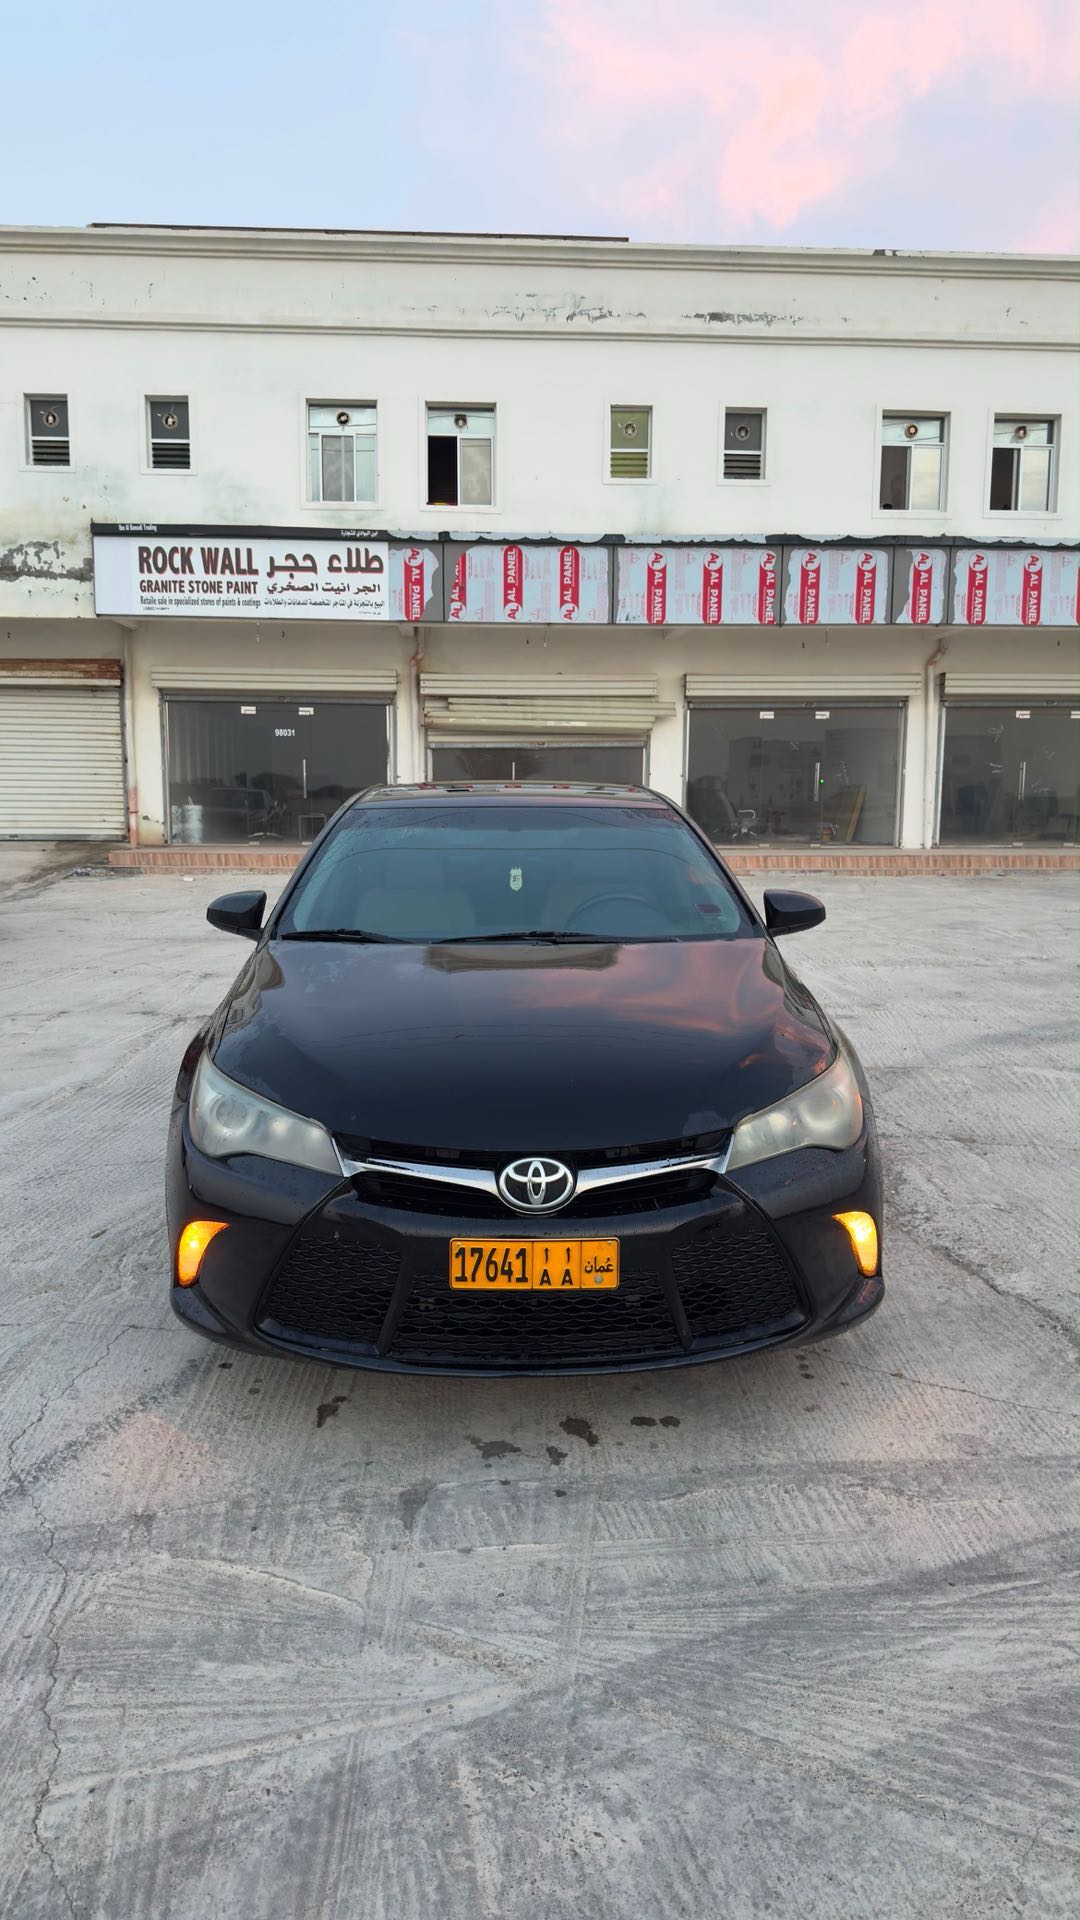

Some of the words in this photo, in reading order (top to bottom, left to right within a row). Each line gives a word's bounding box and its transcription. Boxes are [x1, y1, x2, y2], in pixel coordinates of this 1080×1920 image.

[144, 524, 157, 532] Trading
[138, 546, 195, 574] ROCK
[200, 546, 259, 576] WALL
[266, 553, 318, 579] حجر
[327, 547, 384, 574] طلاء
[507, 548, 515, 584] PANEL
[564, 549, 572, 584] PANEL
[412, 568, 420, 582] AL
[654, 571, 662, 585] AL
[711, 572, 718, 585] AL
[767, 572, 774, 585] AL
[808, 572, 816, 585] AL
[864, 572, 872, 585] AL
[920, 572, 928, 586] AL
[976, 573, 983, 586] AL
[1030, 574, 1038, 587] AL
[140, 579, 185, 593] GRANITE
[189, 580, 224, 594] STONE
[226, 581, 258, 594] PAINT
[267, 581, 318, 594] الصخري
[451, 587, 459, 600] AL
[507, 587, 515, 601] AL
[564, 588, 572, 602] AL
[158, 596, 167, 605] sale
[168, 597, 173, 605] in
[174, 596, 199, 607] specialized
[216, 597, 221, 606] of
[222, 598, 236, 608] paints
[242, 598, 261, 608] coatings
[347, 600, 352, 608] في
[375, 600, 384, 609] البيع
[412, 585, 420, 620] PANEL
[654, 589, 662, 624] PANEL
[710, 589, 718, 624] PANEL
[766, 589, 774, 624] PANEL
[807, 589, 816, 624] PANEL
[862, 589, 871, 623] PANEL
[918, 589, 928, 623] PANEL
[974, 590, 983, 624] PANEL
[1029, 591, 1038, 624] PANEL
[455, 1247, 528, 1283] 17641
[540, 1268, 551, 1286] A
[561, 1268, 573, 1285] A
